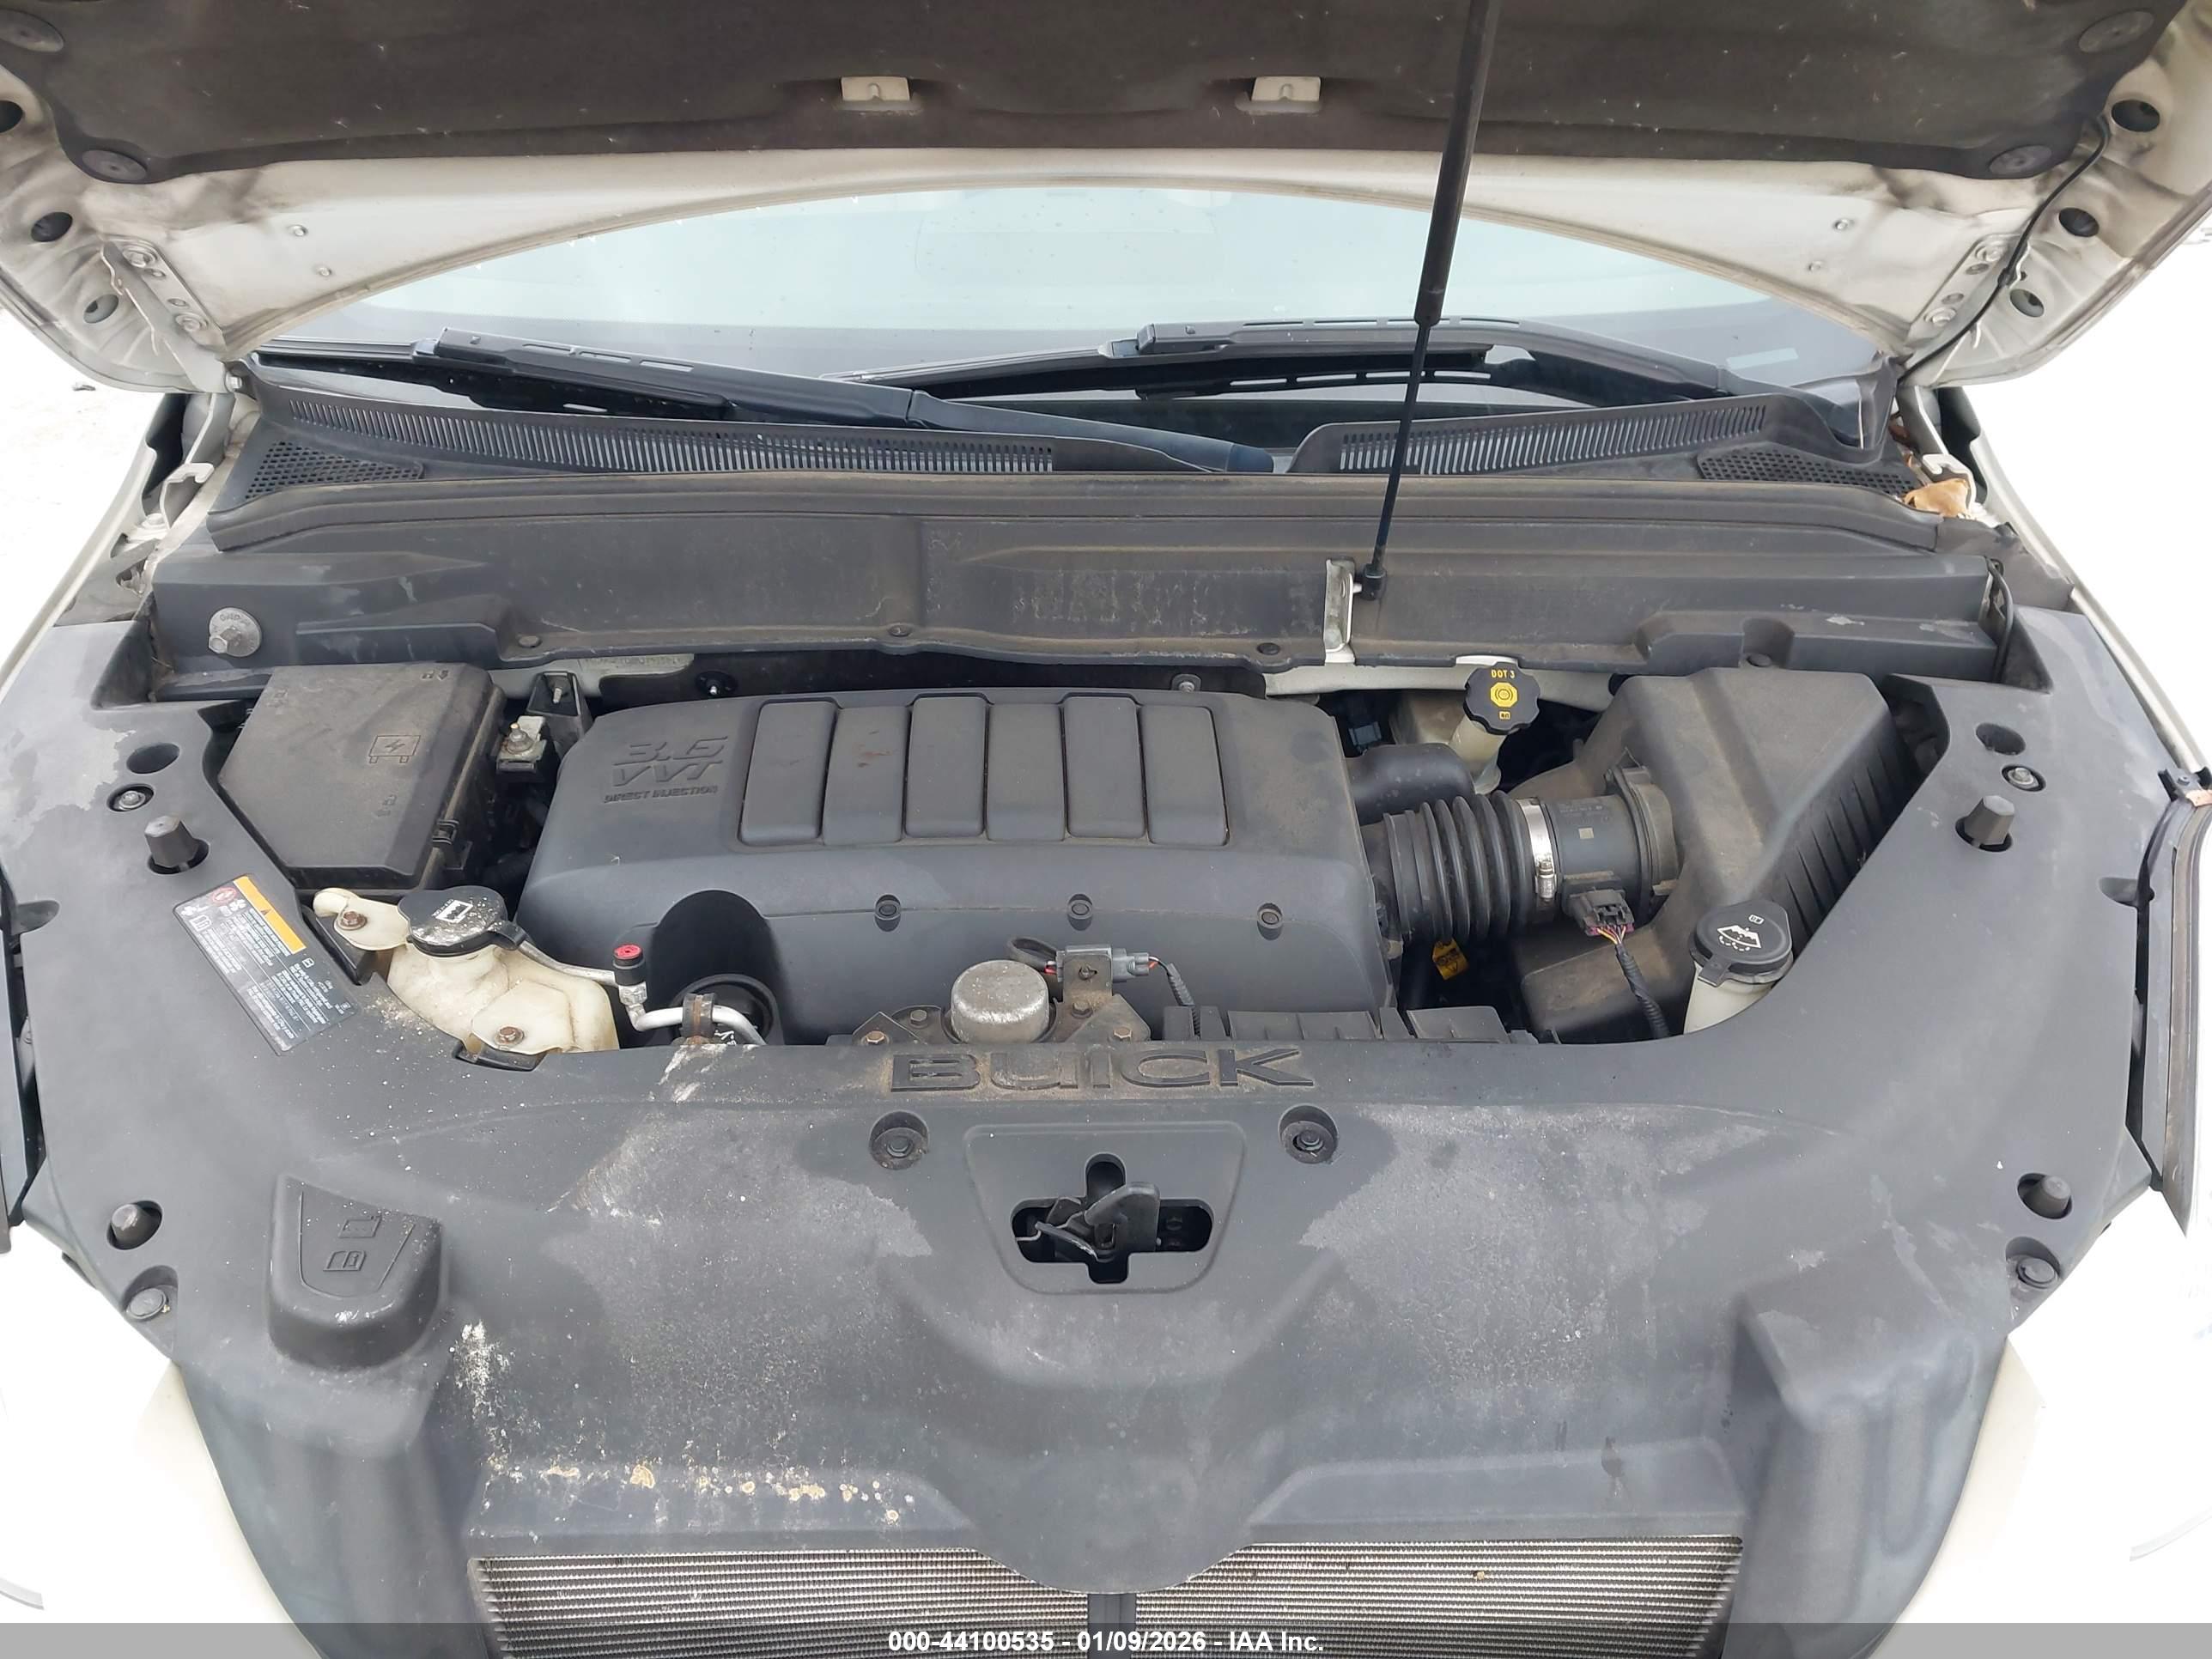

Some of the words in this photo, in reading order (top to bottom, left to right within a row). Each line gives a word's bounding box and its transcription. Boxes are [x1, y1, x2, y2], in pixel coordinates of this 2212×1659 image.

[1491, 669, 1508, 678] DOT
[1510, 670, 1516, 678] 3
[613, 735, 728, 766] 3.6
[611, 760, 723, 787] VVT
[604, 790, 650, 803] DIRECT
[652, 786, 718, 799] INJECTION
[891, 1048, 1315, 1091] BUICK
